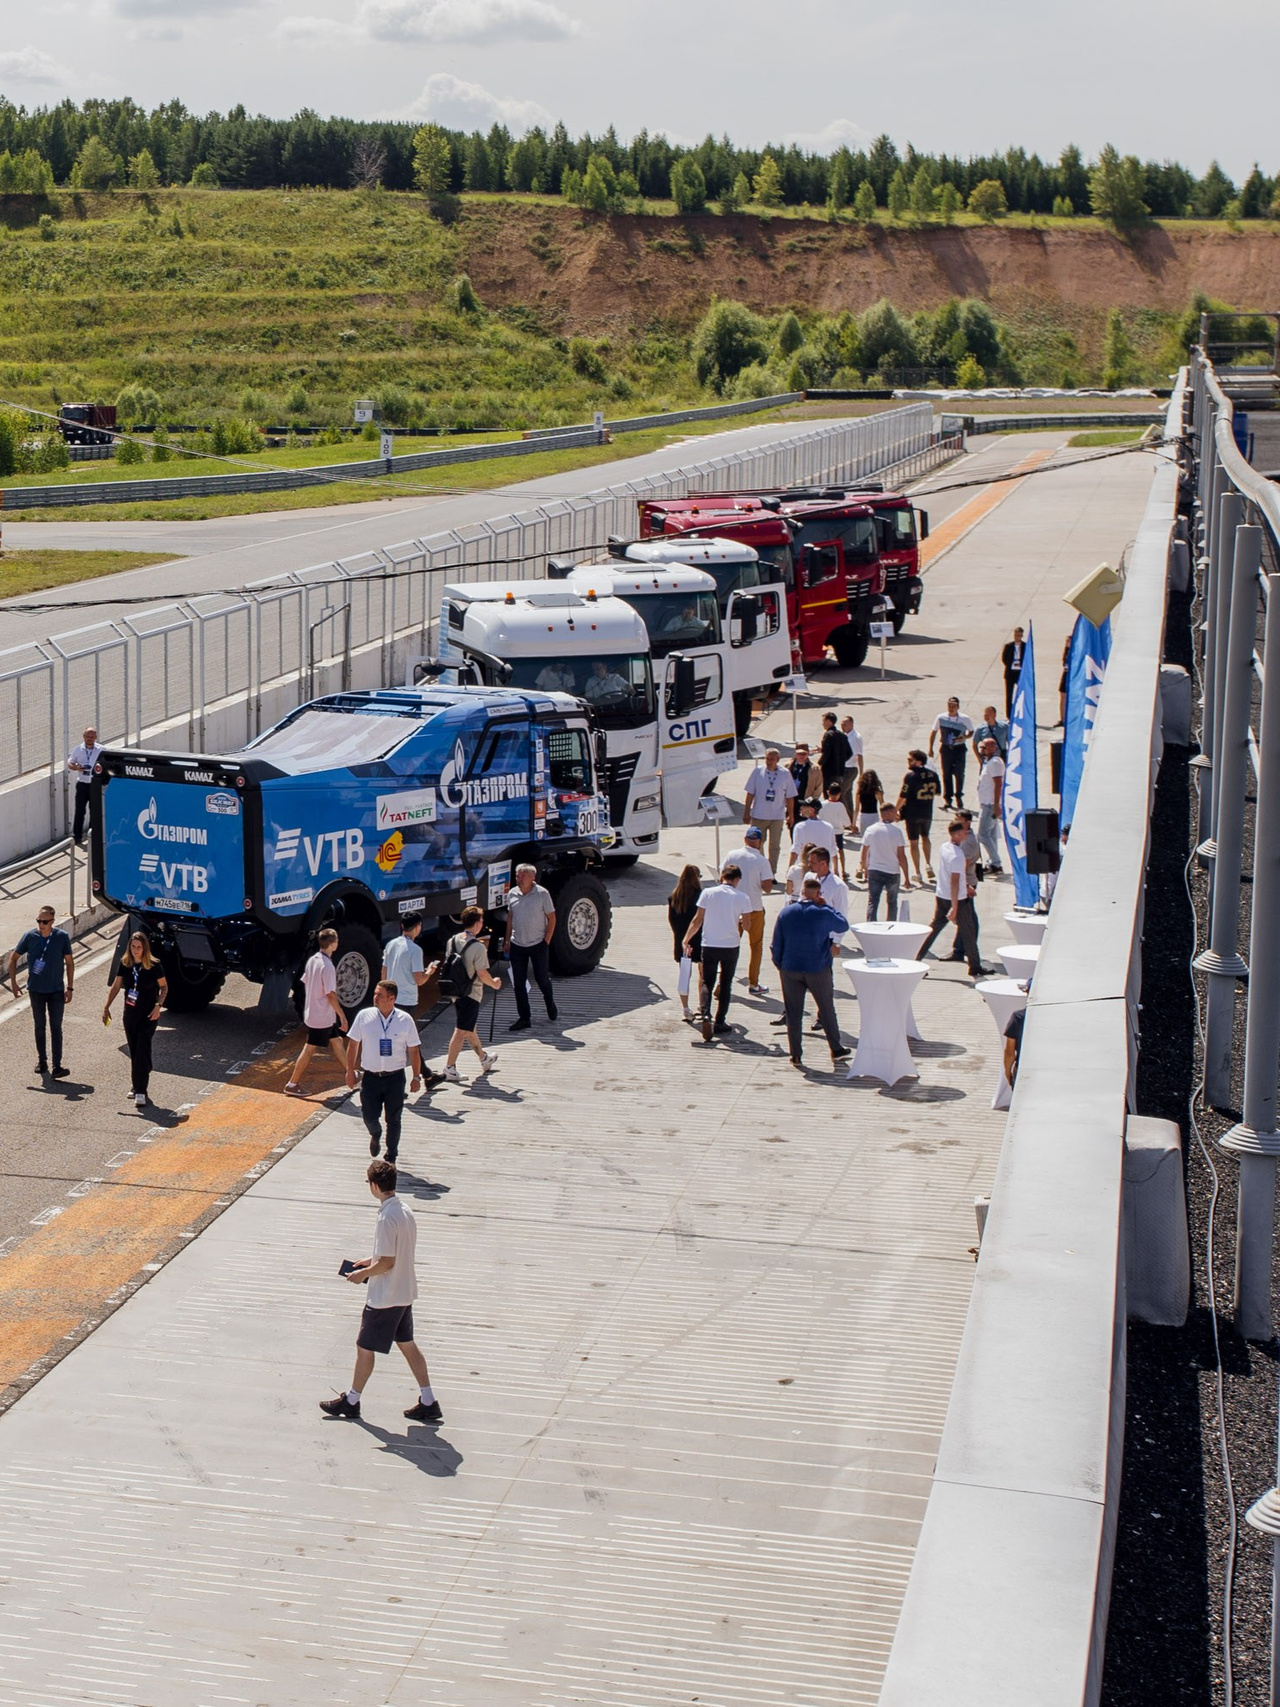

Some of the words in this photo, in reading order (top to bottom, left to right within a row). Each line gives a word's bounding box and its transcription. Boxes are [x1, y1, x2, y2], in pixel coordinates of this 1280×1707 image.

[669, 719, 711, 741] СПГ
[125, 765, 155, 777] KAMAZ
[184, 770, 214, 783] KAMAZ
[468, 771, 528, 806] ГАЗПРОМ
[389, 808, 433, 822] TATNEFT
[580, 810, 597, 834] 300
[158, 824, 207, 845] ГАЗПРОМ
[303, 828, 365, 876] VTB
[160, 862, 208, 893] VTB
